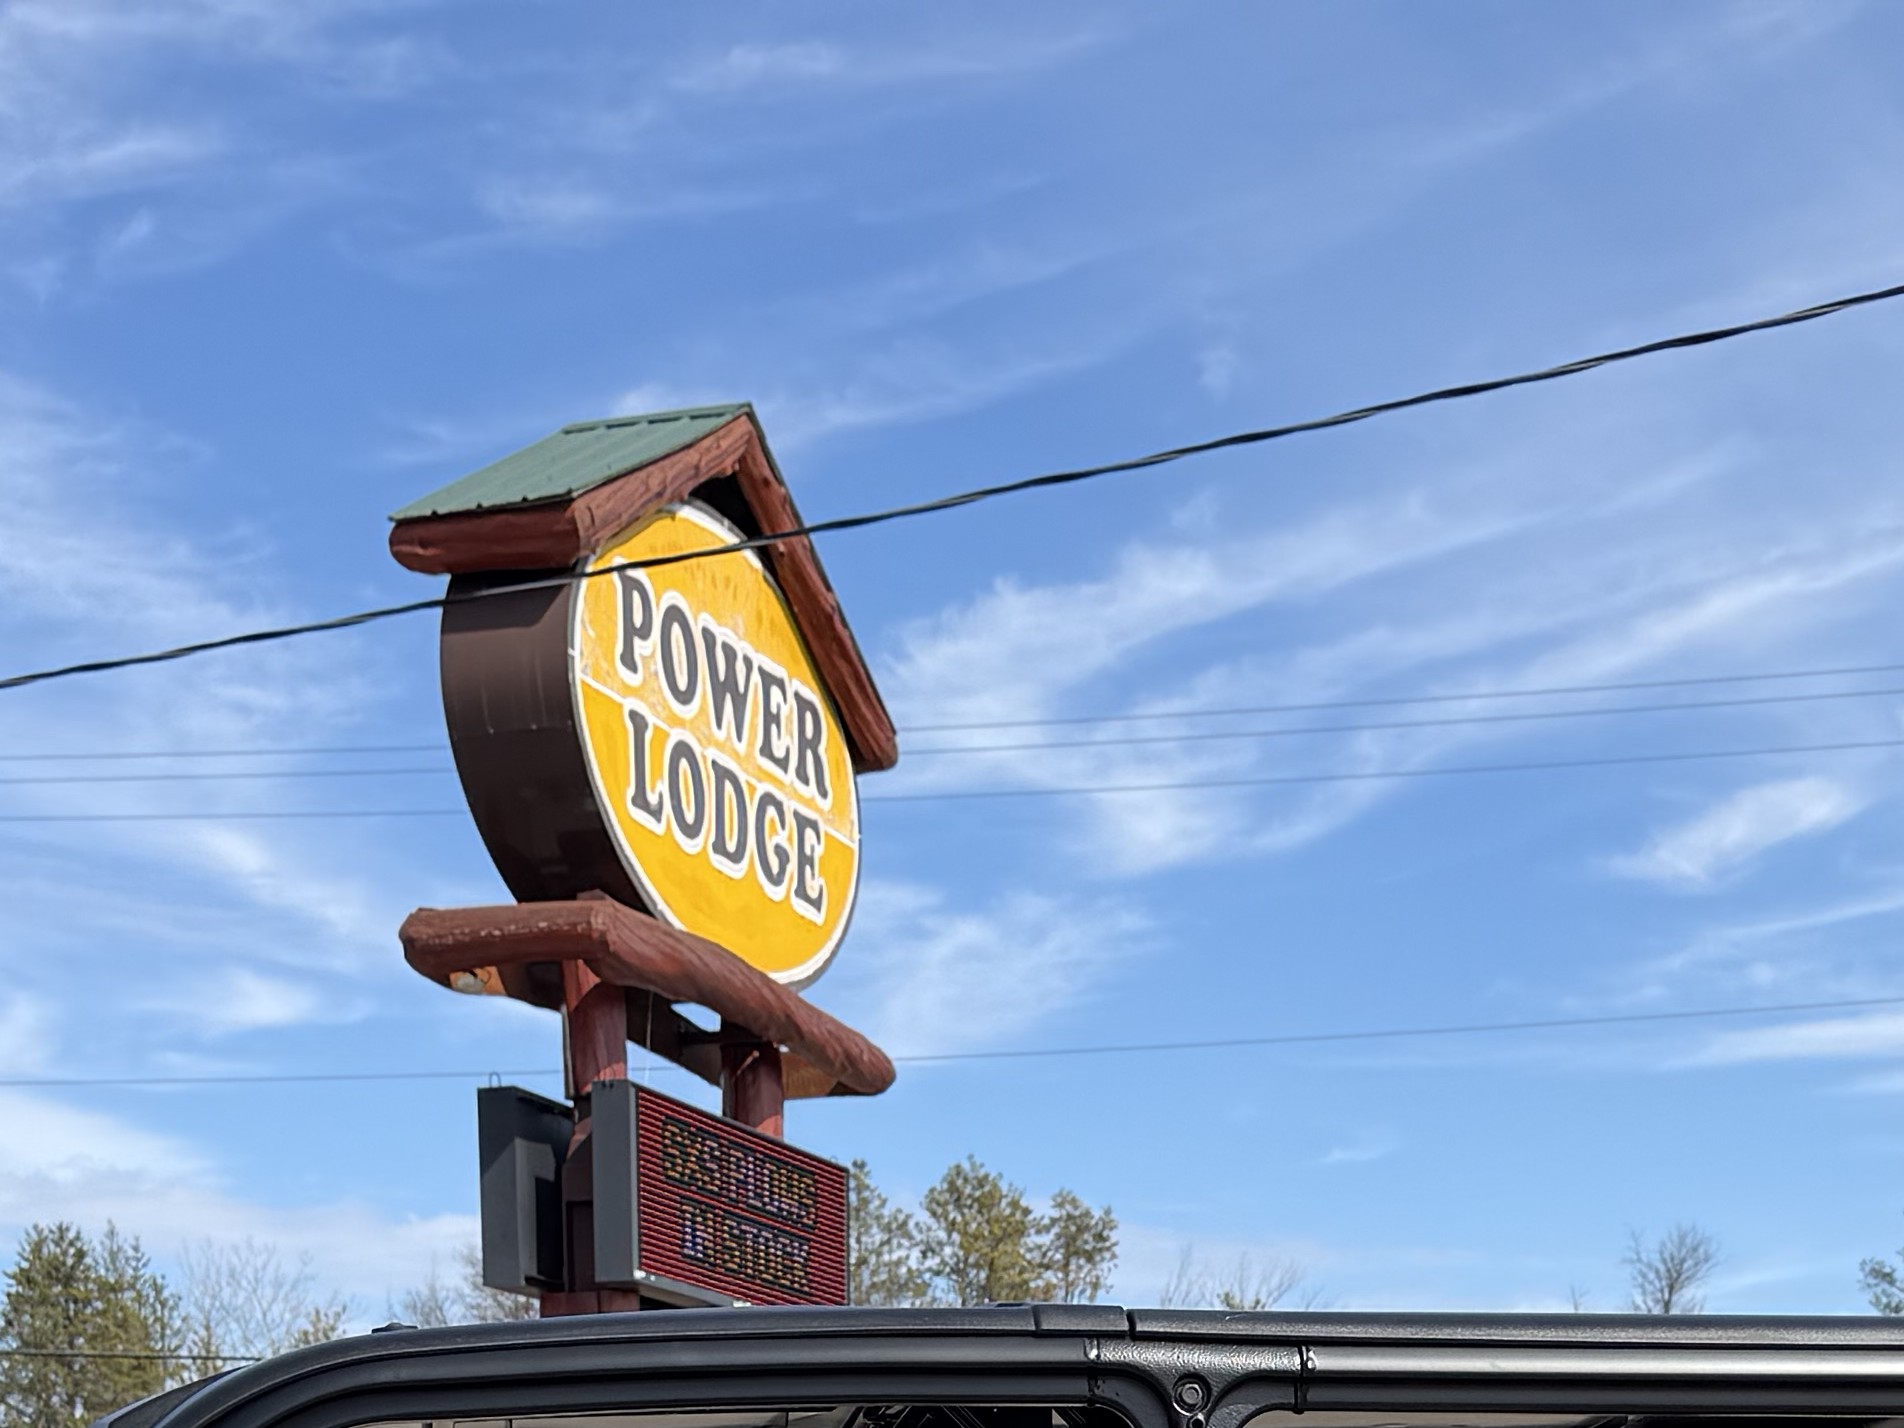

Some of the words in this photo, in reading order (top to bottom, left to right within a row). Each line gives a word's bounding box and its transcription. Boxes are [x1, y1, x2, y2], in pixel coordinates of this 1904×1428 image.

[615, 567, 830, 802] POWER
[627, 706, 826, 917] LODGE
[722, 1218, 810, 1292] STOCK
